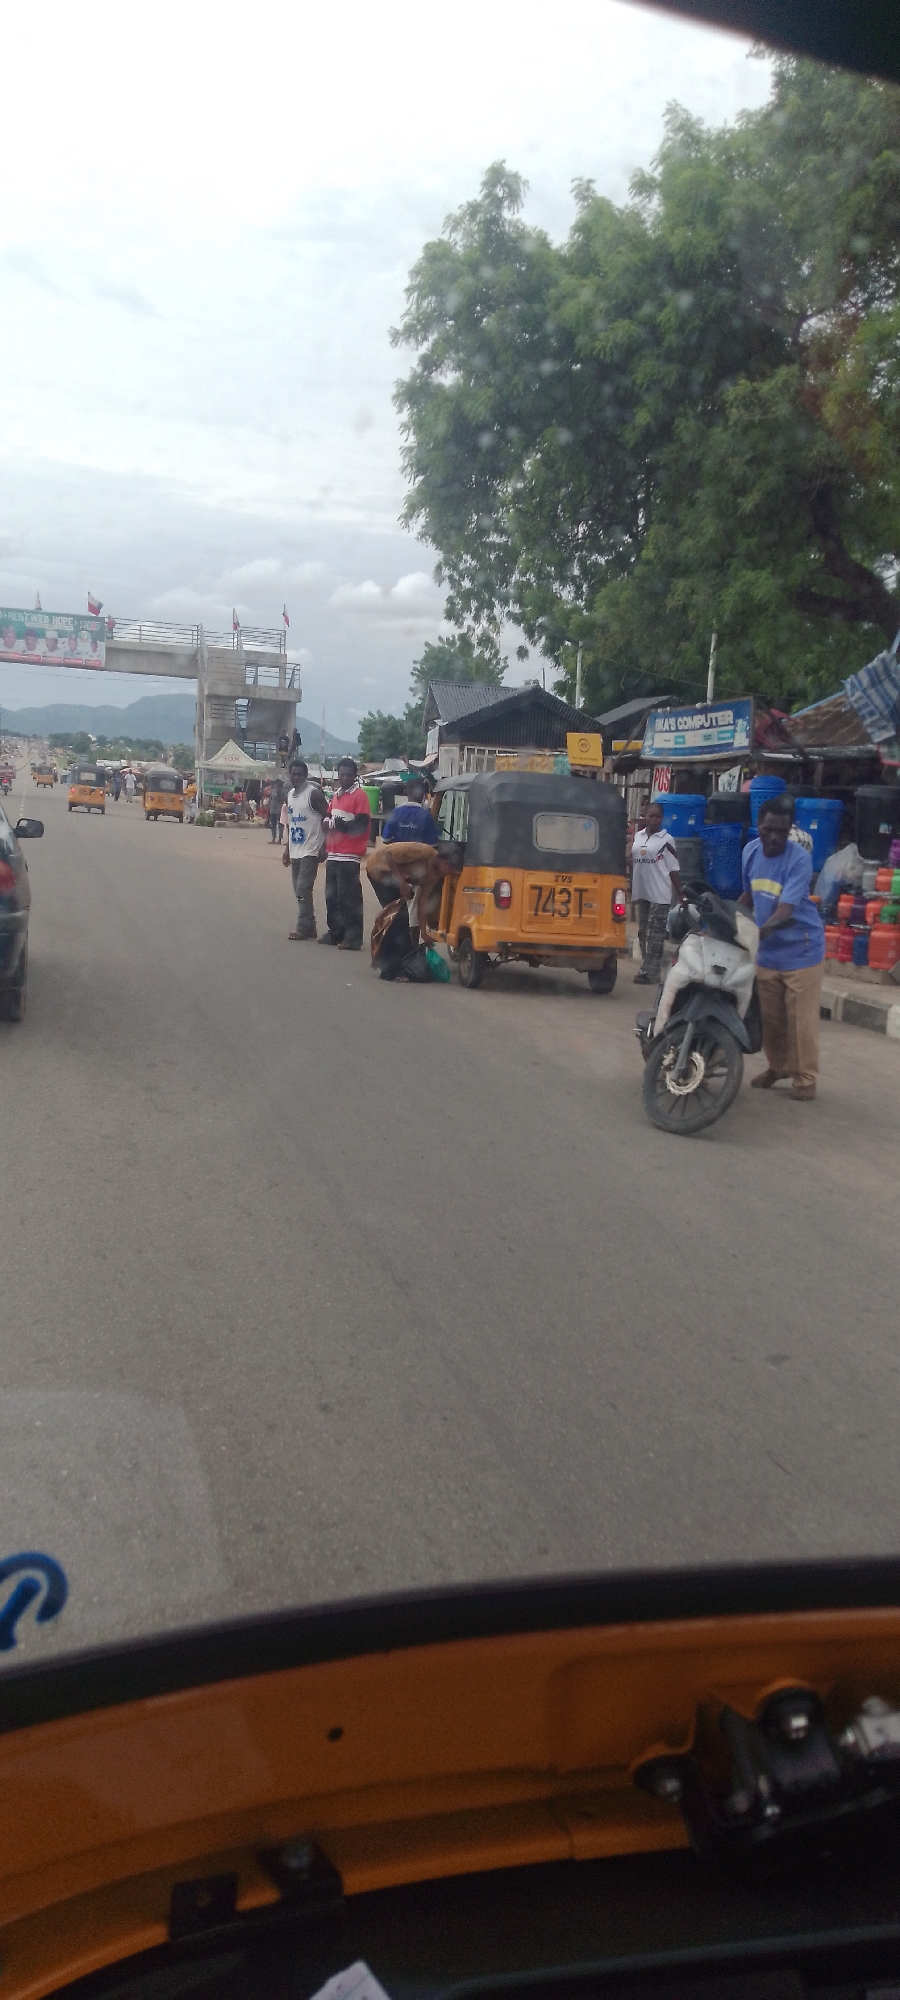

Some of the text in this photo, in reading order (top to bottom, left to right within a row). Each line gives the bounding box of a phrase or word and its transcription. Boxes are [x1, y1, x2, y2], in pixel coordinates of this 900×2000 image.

[7, 611, 50, 624] RENEWED
[52, 616, 74, 626] HOPE
[79, 620, 101, 631] 2027
[677, 710, 733, 731] COMPUTER
[653, 767, 671, 792] POS
[554, 874, 573, 884] TVS
[530, 886, 589, 918] 743T
